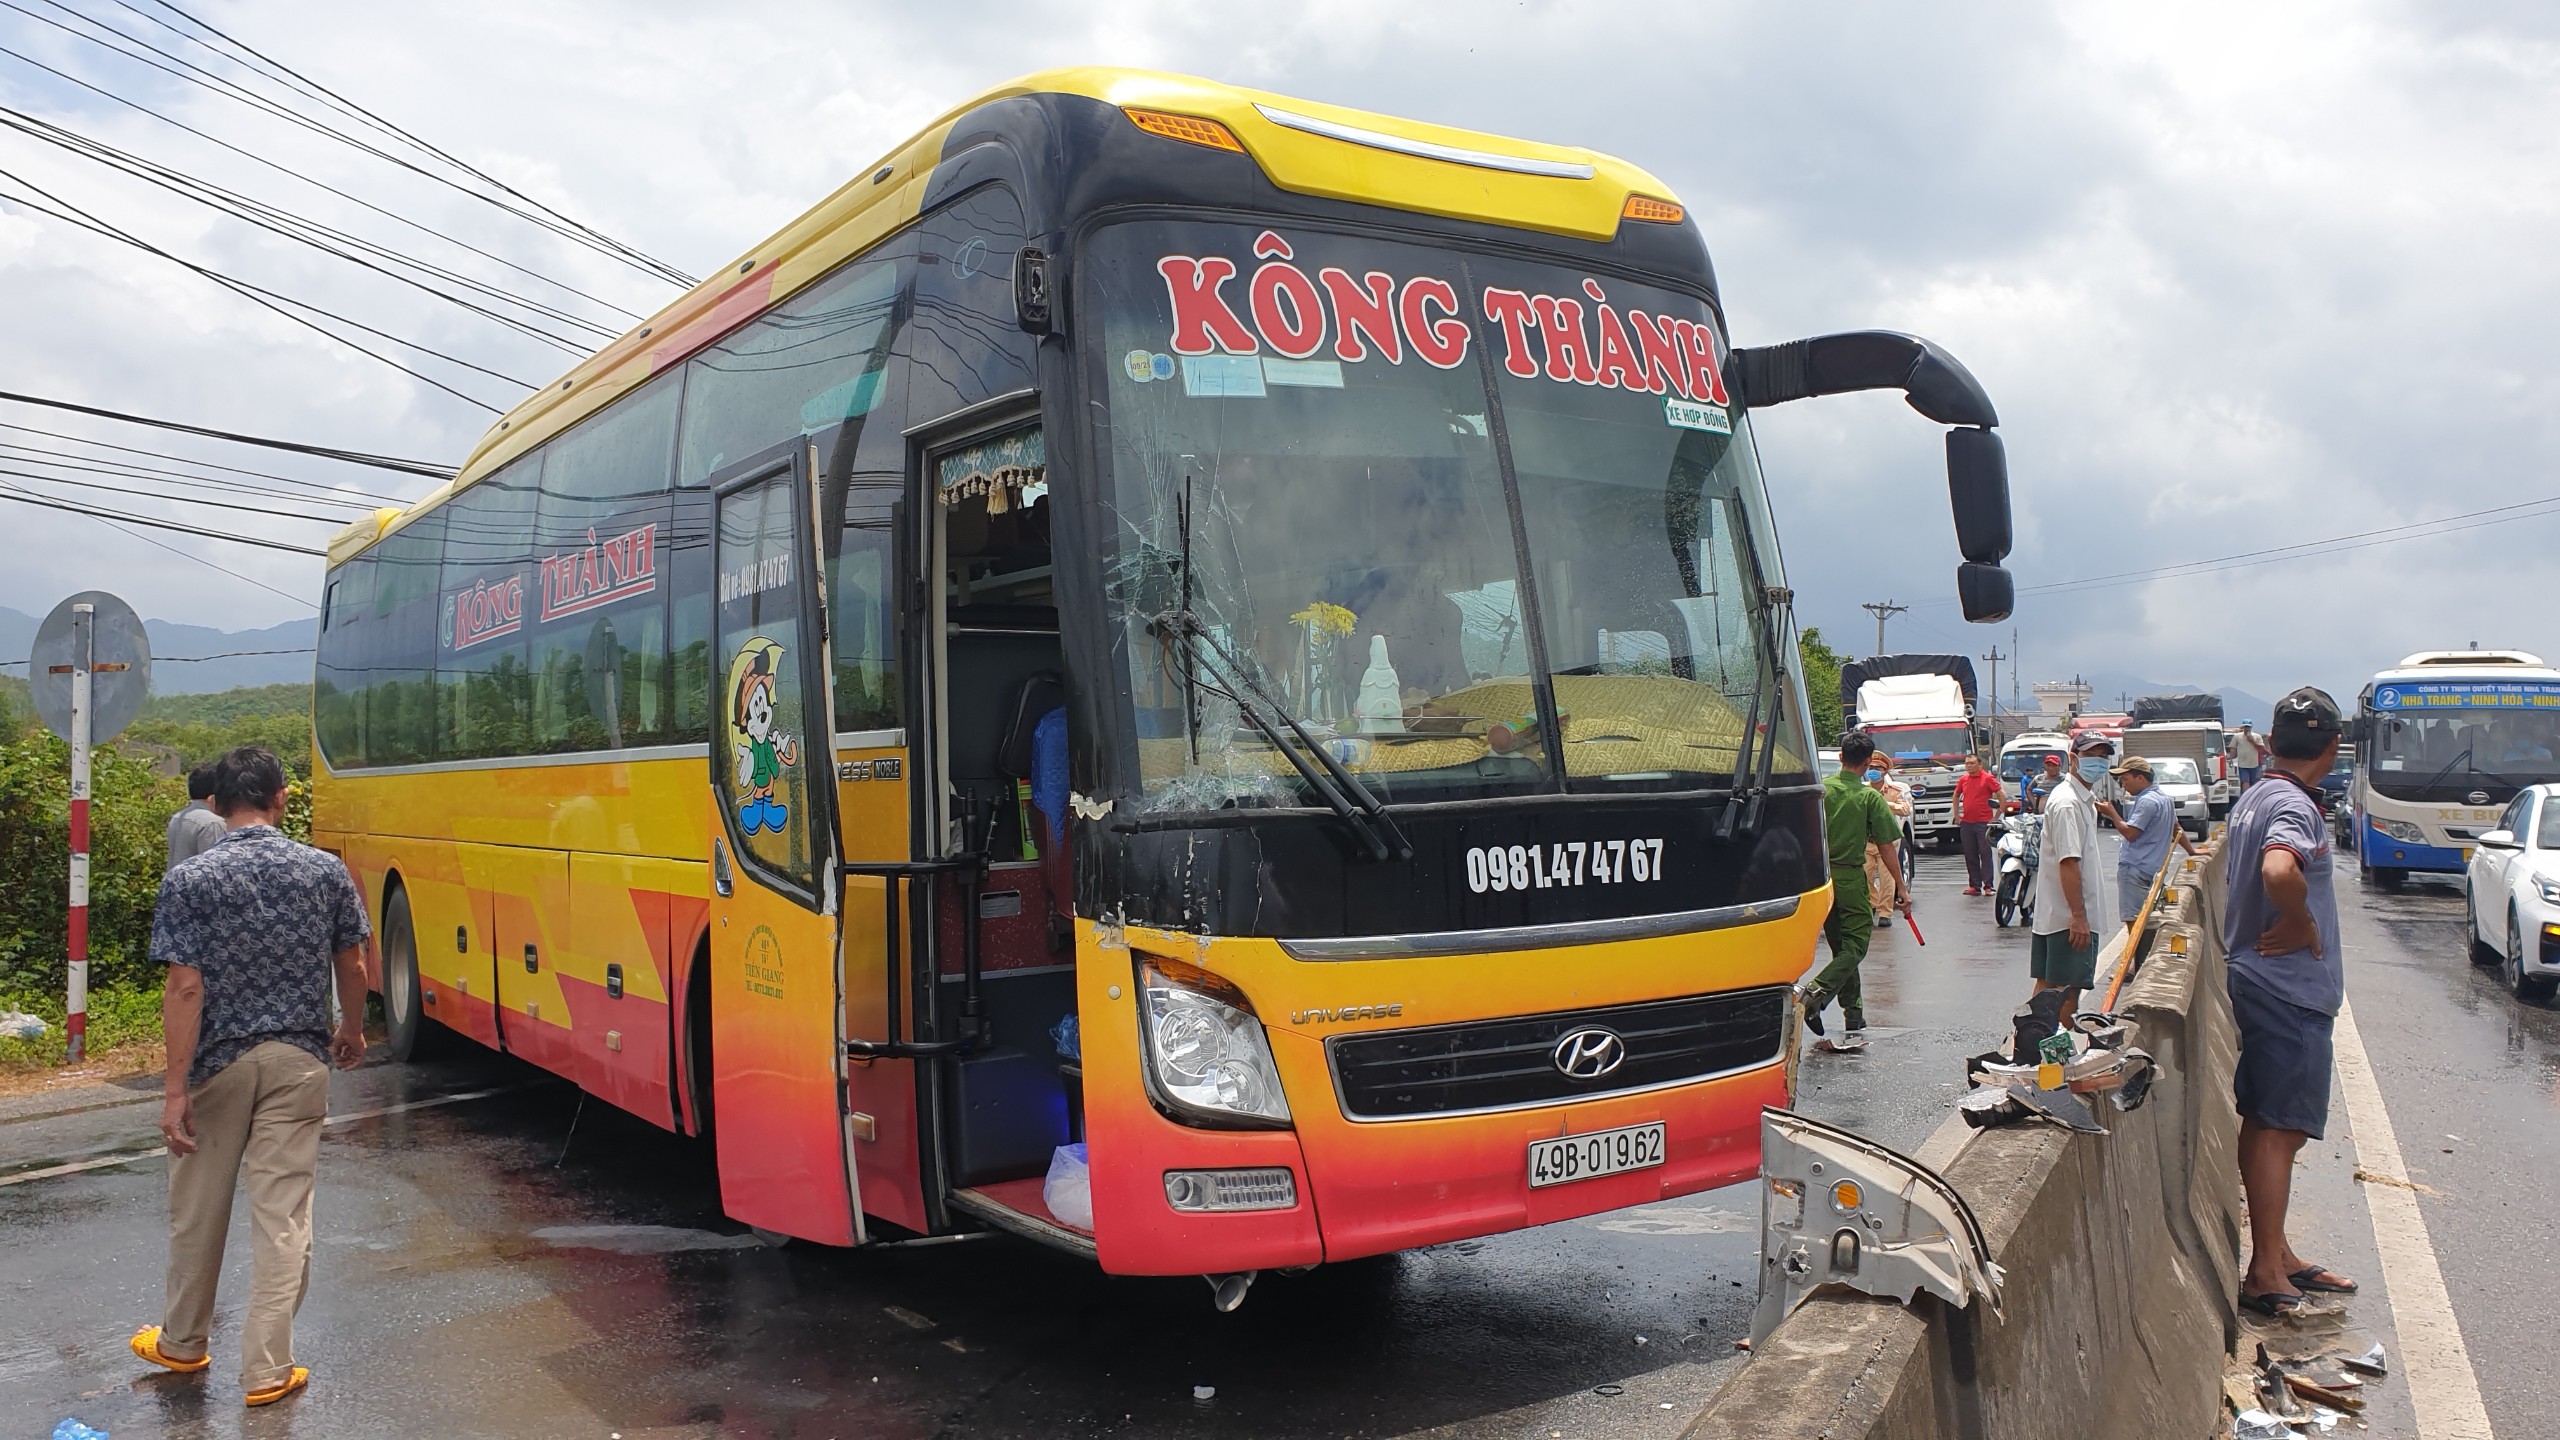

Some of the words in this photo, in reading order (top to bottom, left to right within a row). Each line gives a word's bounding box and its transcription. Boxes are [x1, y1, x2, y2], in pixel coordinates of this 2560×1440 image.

[1156, 230, 1471, 369] KÔNG
[1484, 277, 1730, 408] THÀNH
[1667, 406, 1682, 421] XE
[1682, 407, 1701, 427] HỢP
[455, 572, 523, 651] KÔNG
[539, 523, 657, 623] THÀNH
[2383, 691, 2394, 705] 2
[2441, 685, 2449, 693] TY
[2402, 695, 2424, 706] NHA
[2427, 695, 2462, 706] TRANG
[2471, 695, 2498, 706] NINH
[875, 760, 899, 777] NOBLE
[2439, 808, 2464, 820] XE
[1291, 1003, 1404, 1025] UNIVERSE
[1535, 1128, 1661, 1182] 49B-019.62
